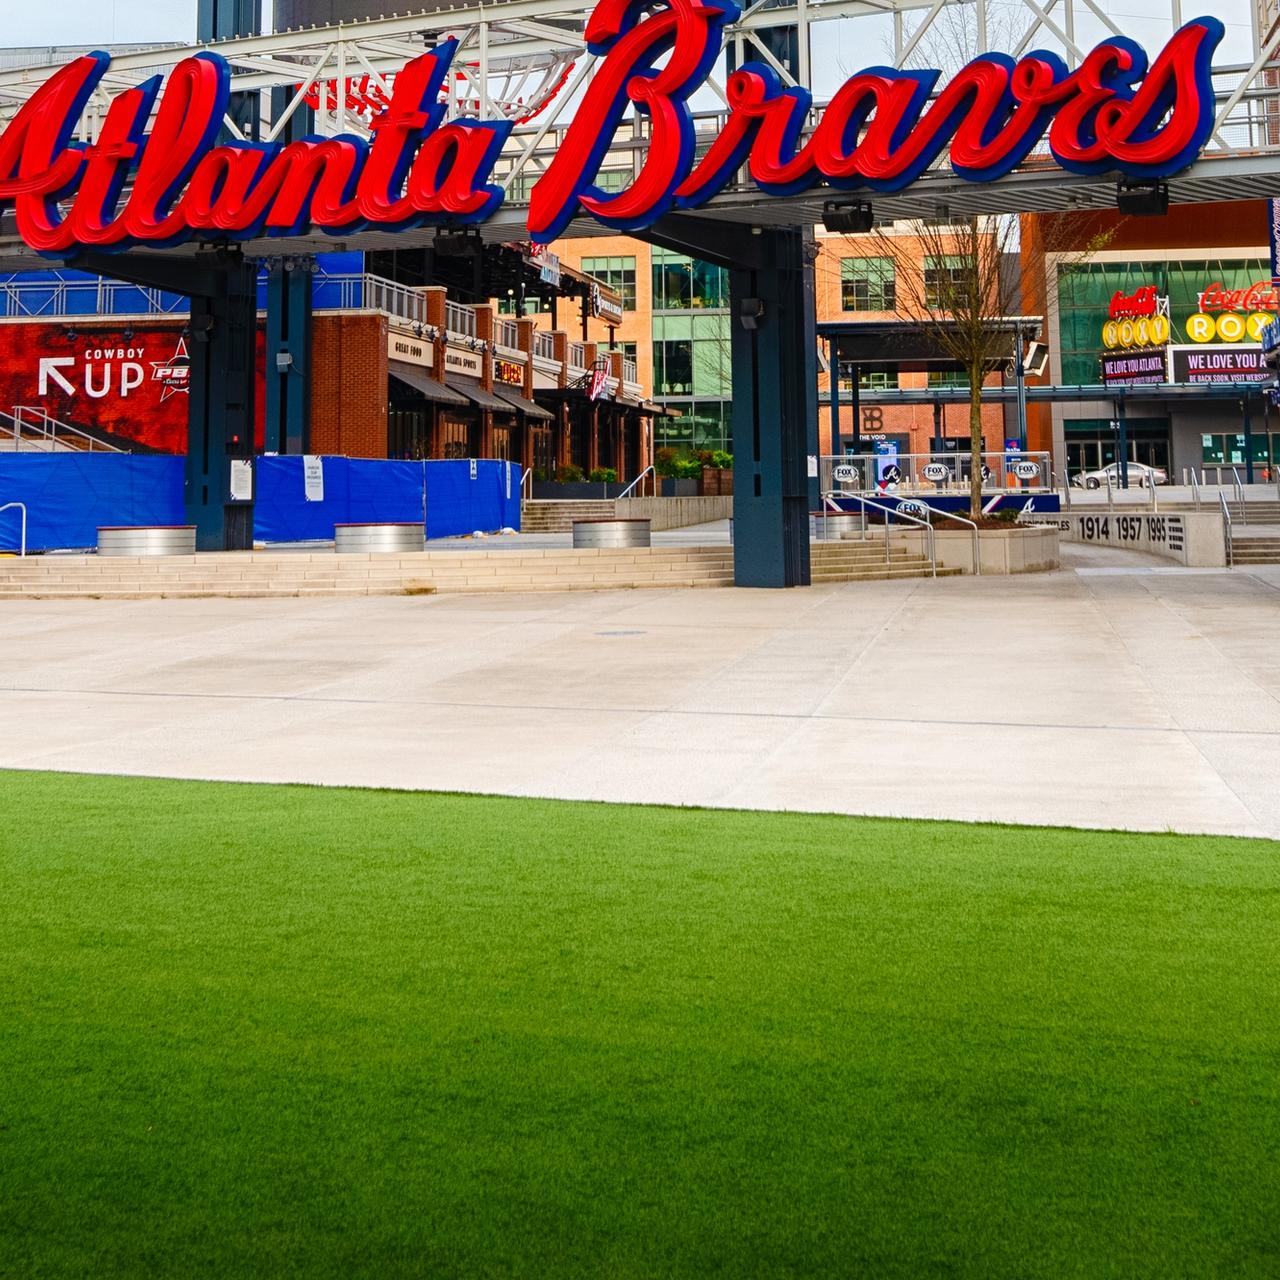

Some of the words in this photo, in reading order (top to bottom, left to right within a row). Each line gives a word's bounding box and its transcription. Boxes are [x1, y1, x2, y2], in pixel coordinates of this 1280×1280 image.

[1105, 317, 1165, 345] ROXY
[85, 348, 145, 360] COWBOY
[1188, 355, 1205, 369] WE
[1207, 354, 1233, 369] LOVE
[1235, 353, 1257, 368] YOU
[156, 368, 190, 379] PB
[1114, 361, 1127, 373] LOVE
[1127, 359, 1138, 372] YOU
[85, 362, 145, 398] UP
[837, 468, 852, 476] FOX
[927, 466, 942, 474] FOX
[1019, 465, 1034, 473] FOX
[1080, 517, 1110, 540] 1914
[1116, 517, 1142, 541] 1957
[1146, 517, 1167, 542] 1995
